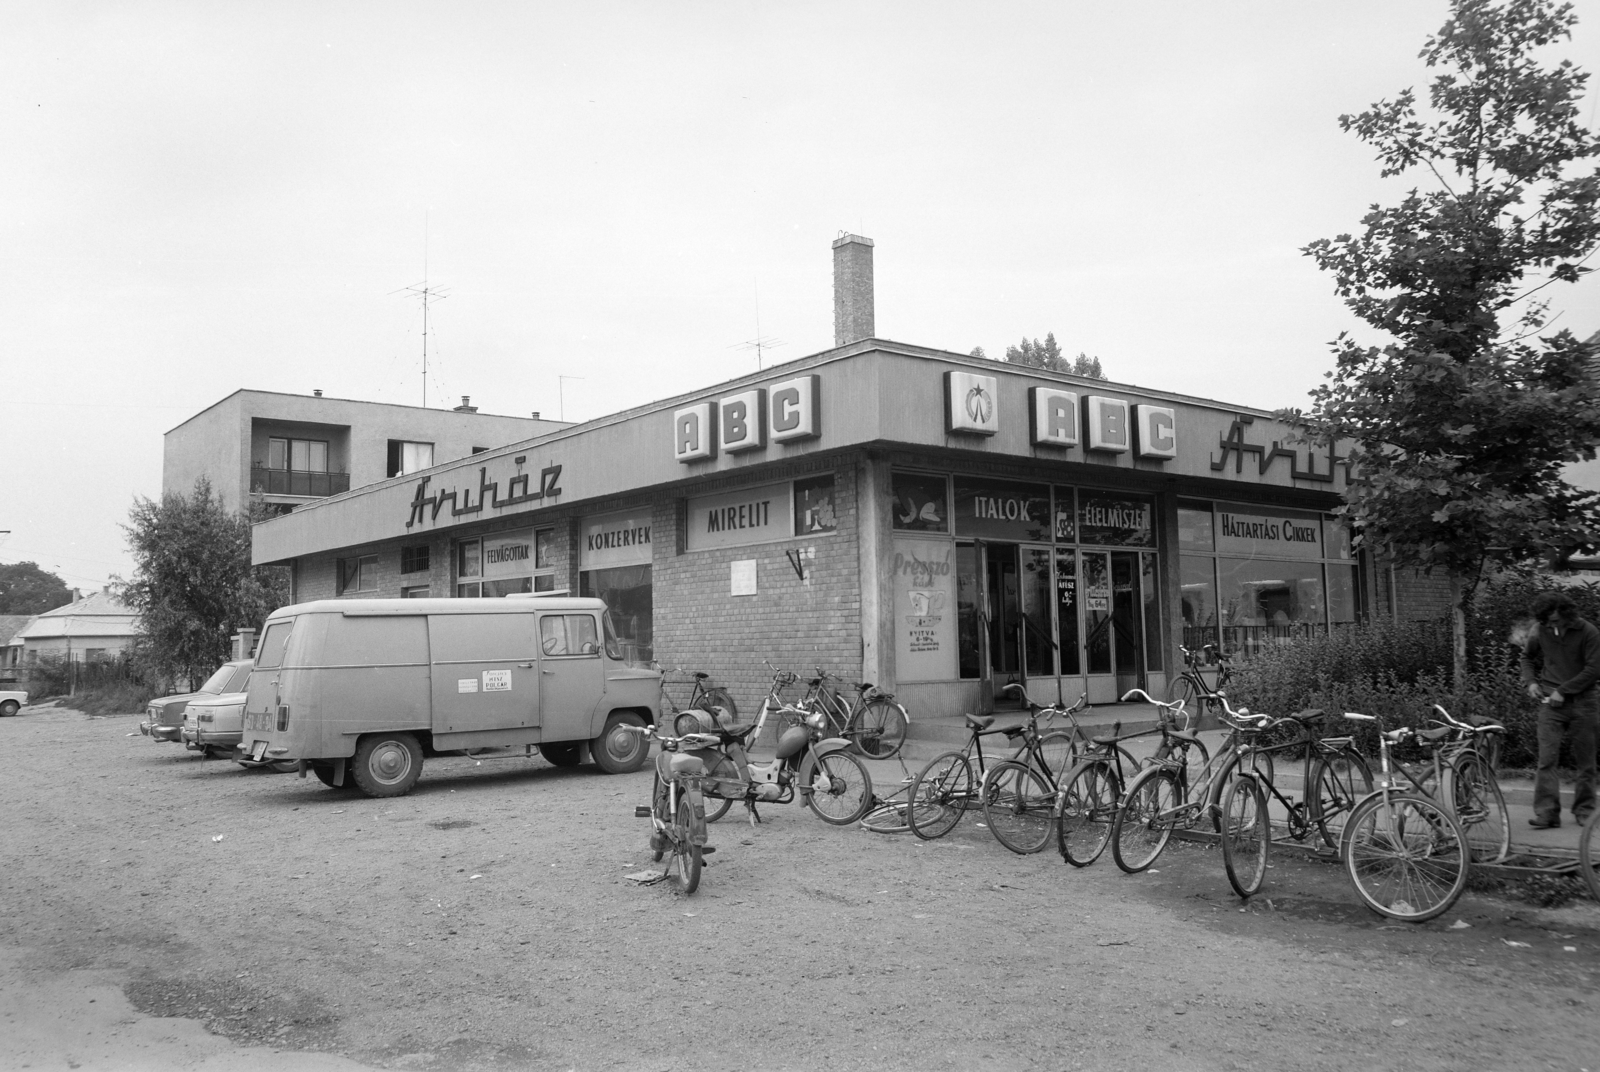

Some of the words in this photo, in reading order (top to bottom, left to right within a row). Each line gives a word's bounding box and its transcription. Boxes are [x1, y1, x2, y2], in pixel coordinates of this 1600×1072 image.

[677, 387, 800, 455] ABC
[1047, 395, 1174, 451] ABC
[405, 455, 562, 528] Áruház
[707, 501, 770, 533] MIRELIT
[975, 496, 1030, 521] ITALOK
[588, 526, 651, 551] KONZERVEK
[487, 544, 529, 564] FELVÁGOTTAK
[892, 549, 951, 576] Presszó
